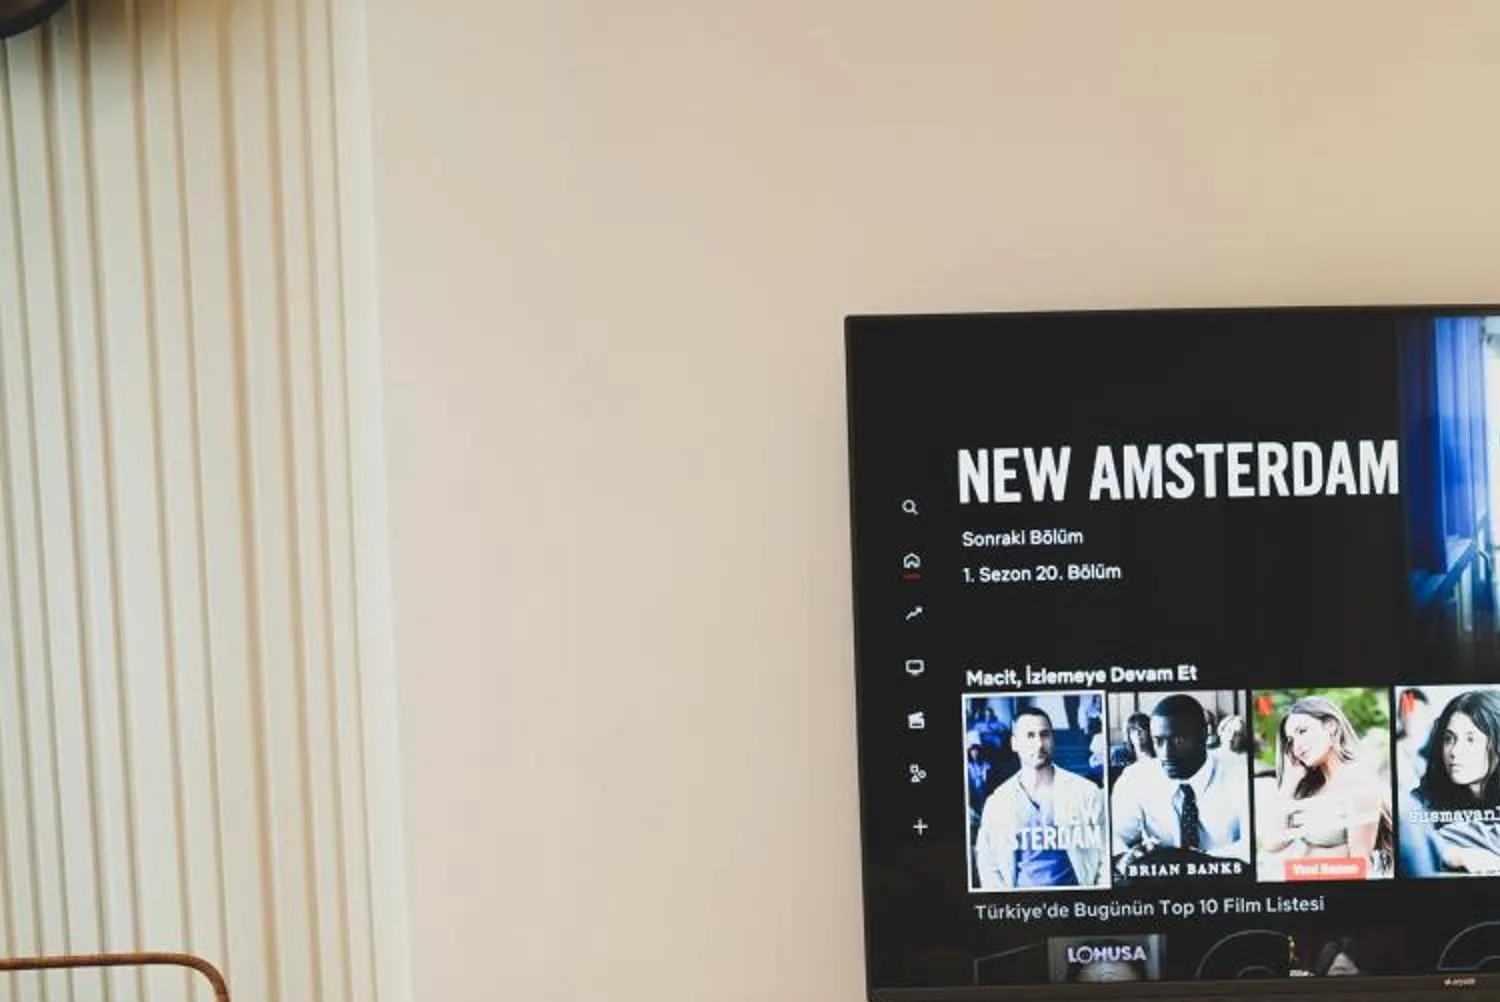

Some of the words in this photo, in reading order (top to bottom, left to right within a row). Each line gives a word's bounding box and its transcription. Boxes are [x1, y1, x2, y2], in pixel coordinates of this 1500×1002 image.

[957, 445, 1072, 504] NEW
[1089, 439, 1399, 500] AMSTERDAM
[962, 529, 1026, 547] Sonraki
[1029, 527, 1084, 545] Bölüm
[963, 567, 975, 583] 1.
[979, 566, 1032, 583] Sezon
[1035, 564, 1063, 581] 20.
[1067, 562, 1122, 581] Bölüm
[966, 668, 1022, 689] Macit,
[1025, 664, 1107, 688] İzlemeye
[1109, 665, 1174, 683] Devam
[1177, 664, 1198, 682] Et
[1128, 863, 1181, 877] BRIAN
[1186, 861, 1243, 875] BANKS
[974, 901, 1070, 923] Türkiye'de
[1073, 899, 1155, 922] Bugünün
[1158, 899, 1195, 919] Top
[1199, 897, 1219, 915] 10
[1223, 896, 1262, 913] Film
[1265, 895, 1325, 913] Listesi
[1067, 945, 1147, 964] LOHUSA
